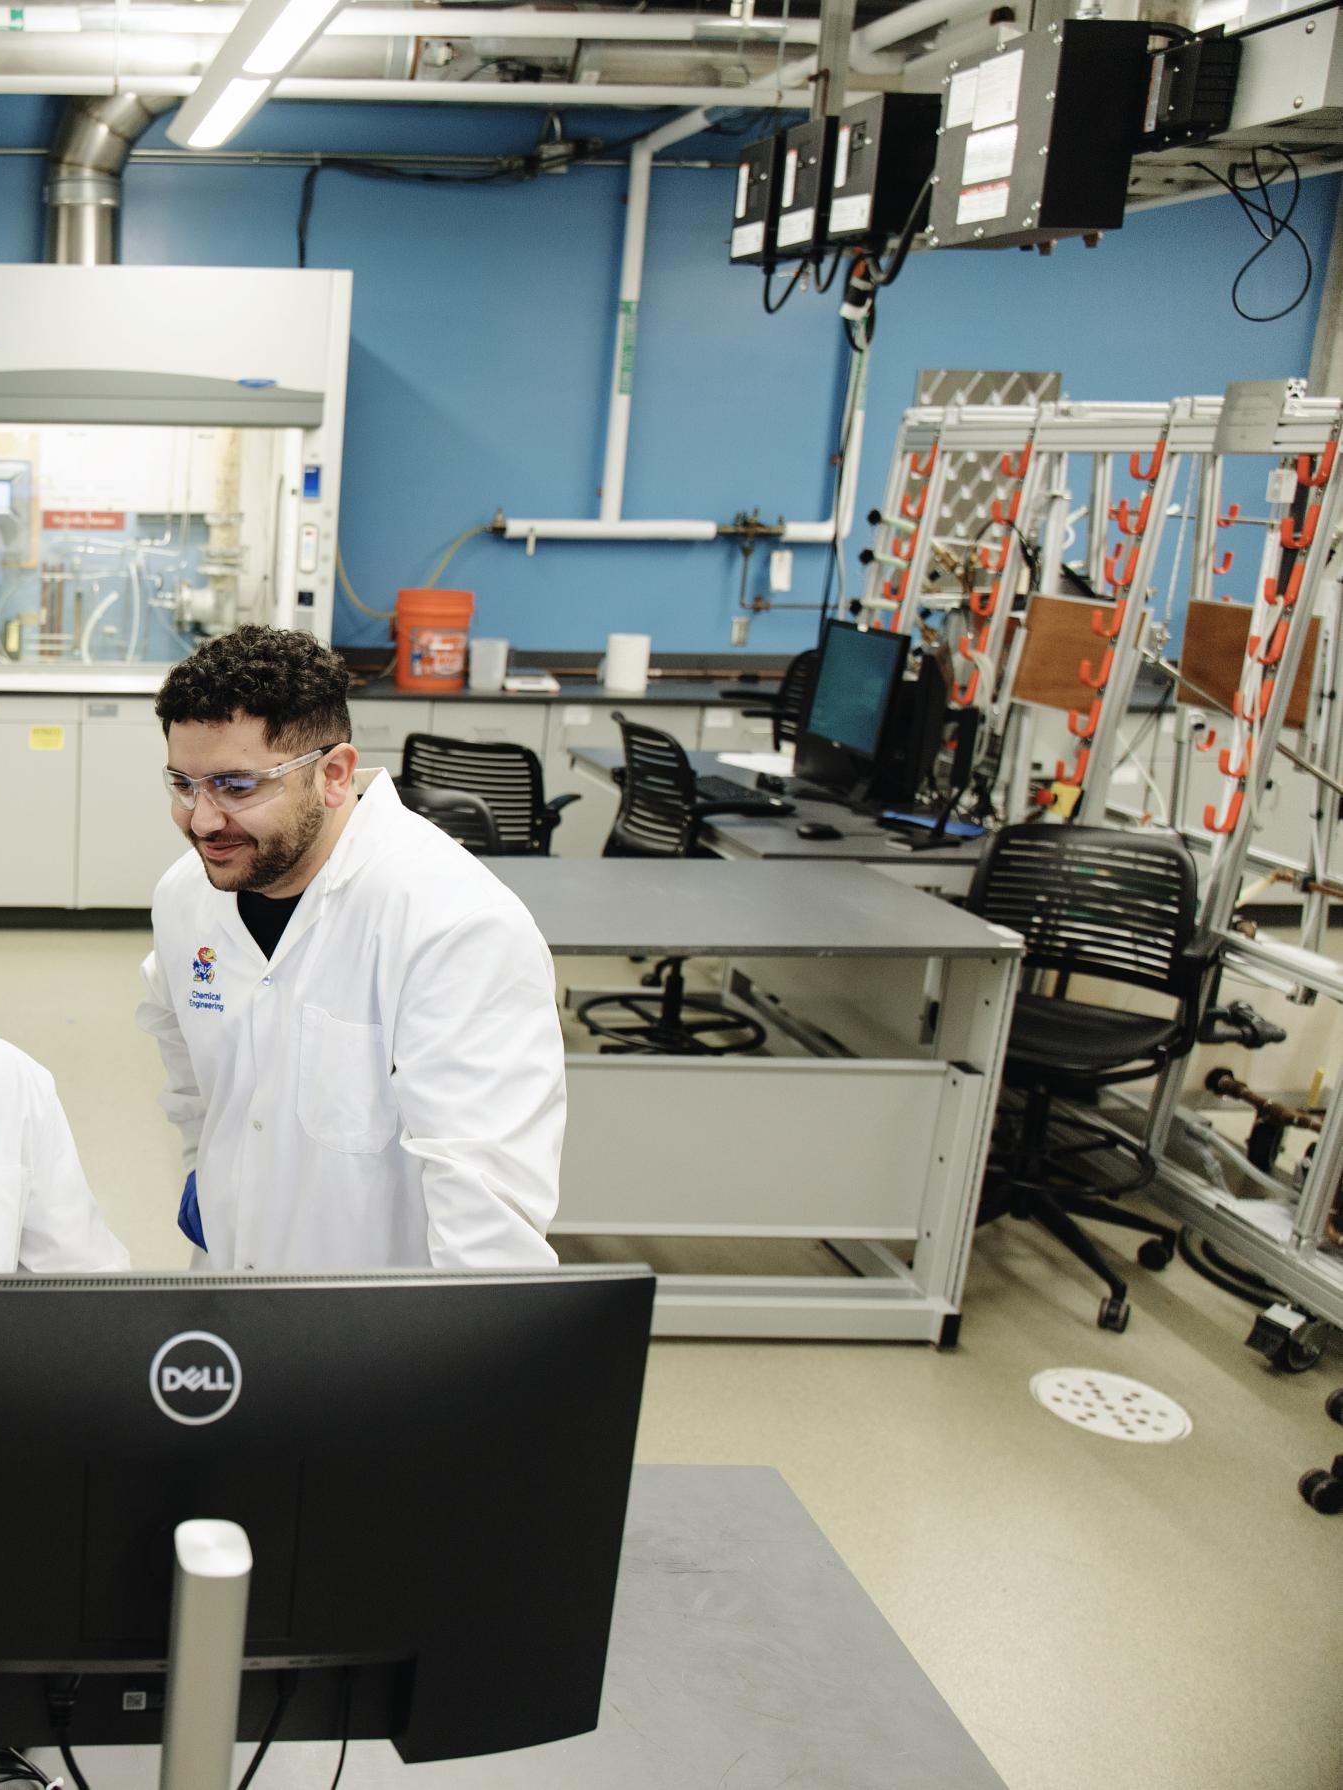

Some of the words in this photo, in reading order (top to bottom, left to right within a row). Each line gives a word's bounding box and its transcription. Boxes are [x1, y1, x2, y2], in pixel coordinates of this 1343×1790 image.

[192, 990, 221, 1001] Chemical
[189, 999, 224, 1011] Engineering
[161, 1366, 232, 1392] DELL
